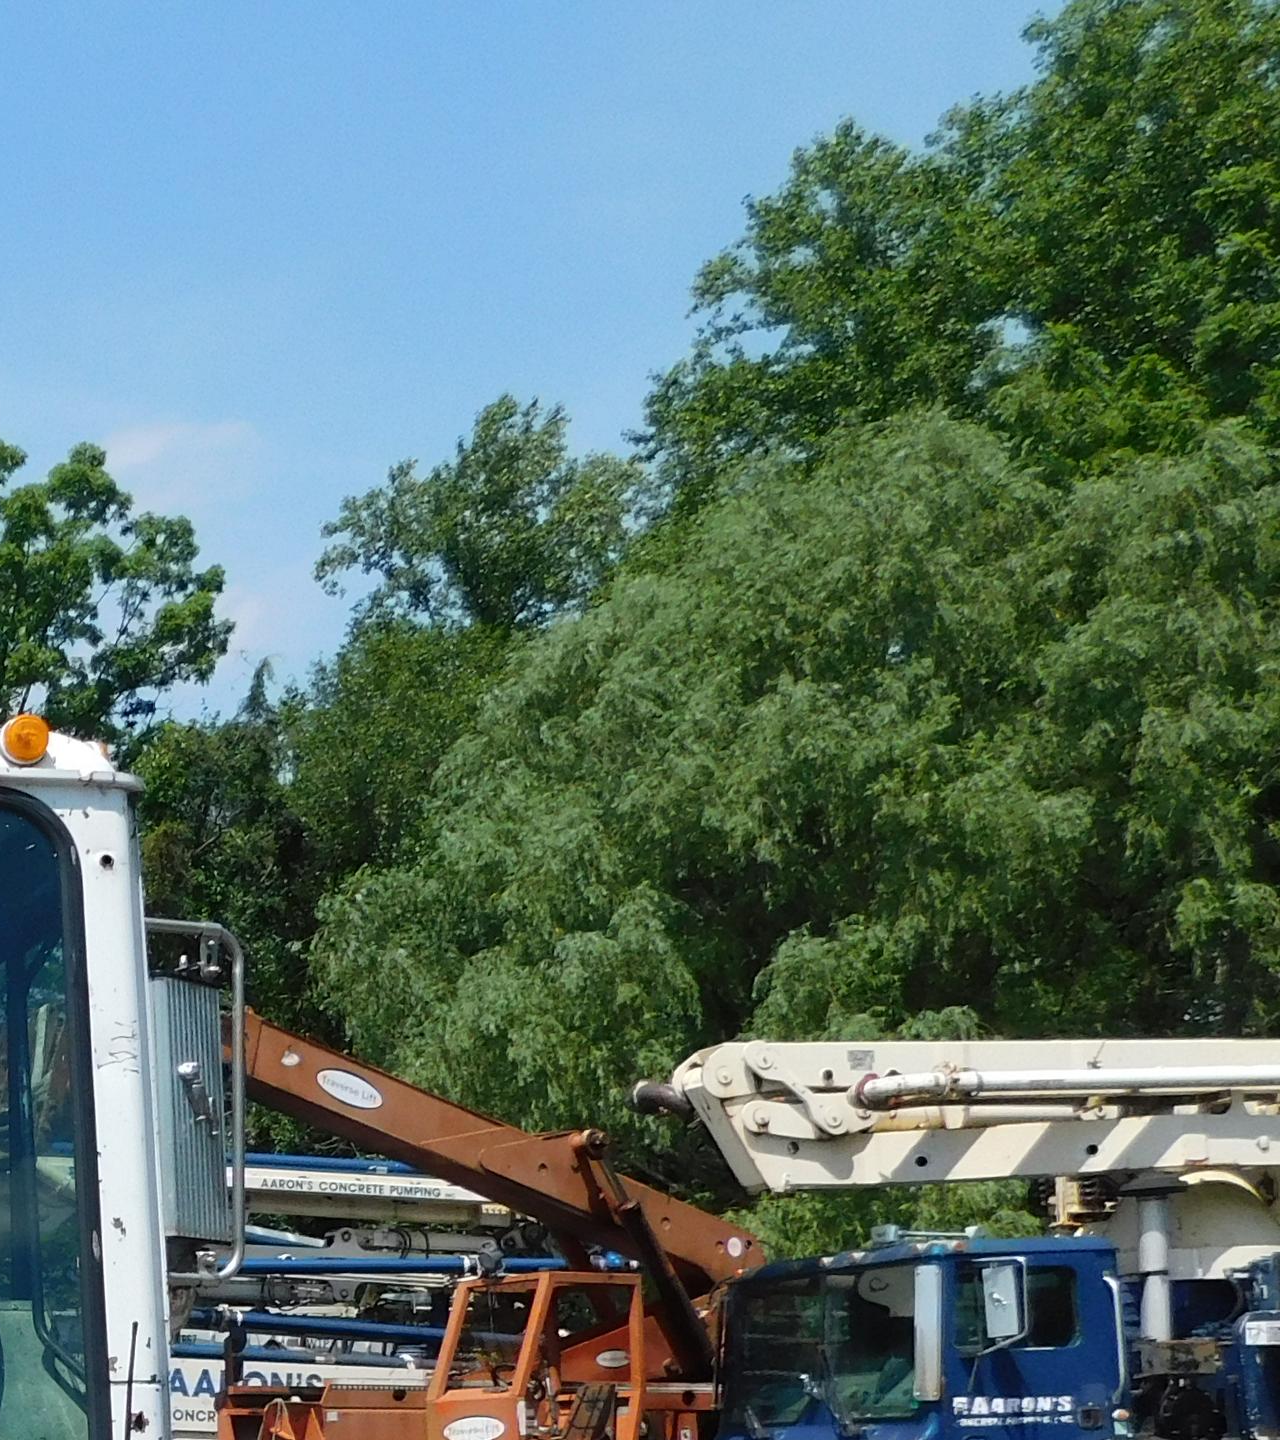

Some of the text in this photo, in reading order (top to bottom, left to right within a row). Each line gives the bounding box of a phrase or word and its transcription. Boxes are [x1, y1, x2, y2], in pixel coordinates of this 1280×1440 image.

[260, 1178, 441, 1198] AARON'S CONCRETE PUMPING
[169, 1368, 323, 1397] AAON'S
[172, 1409, 216, 1423] ONCR
